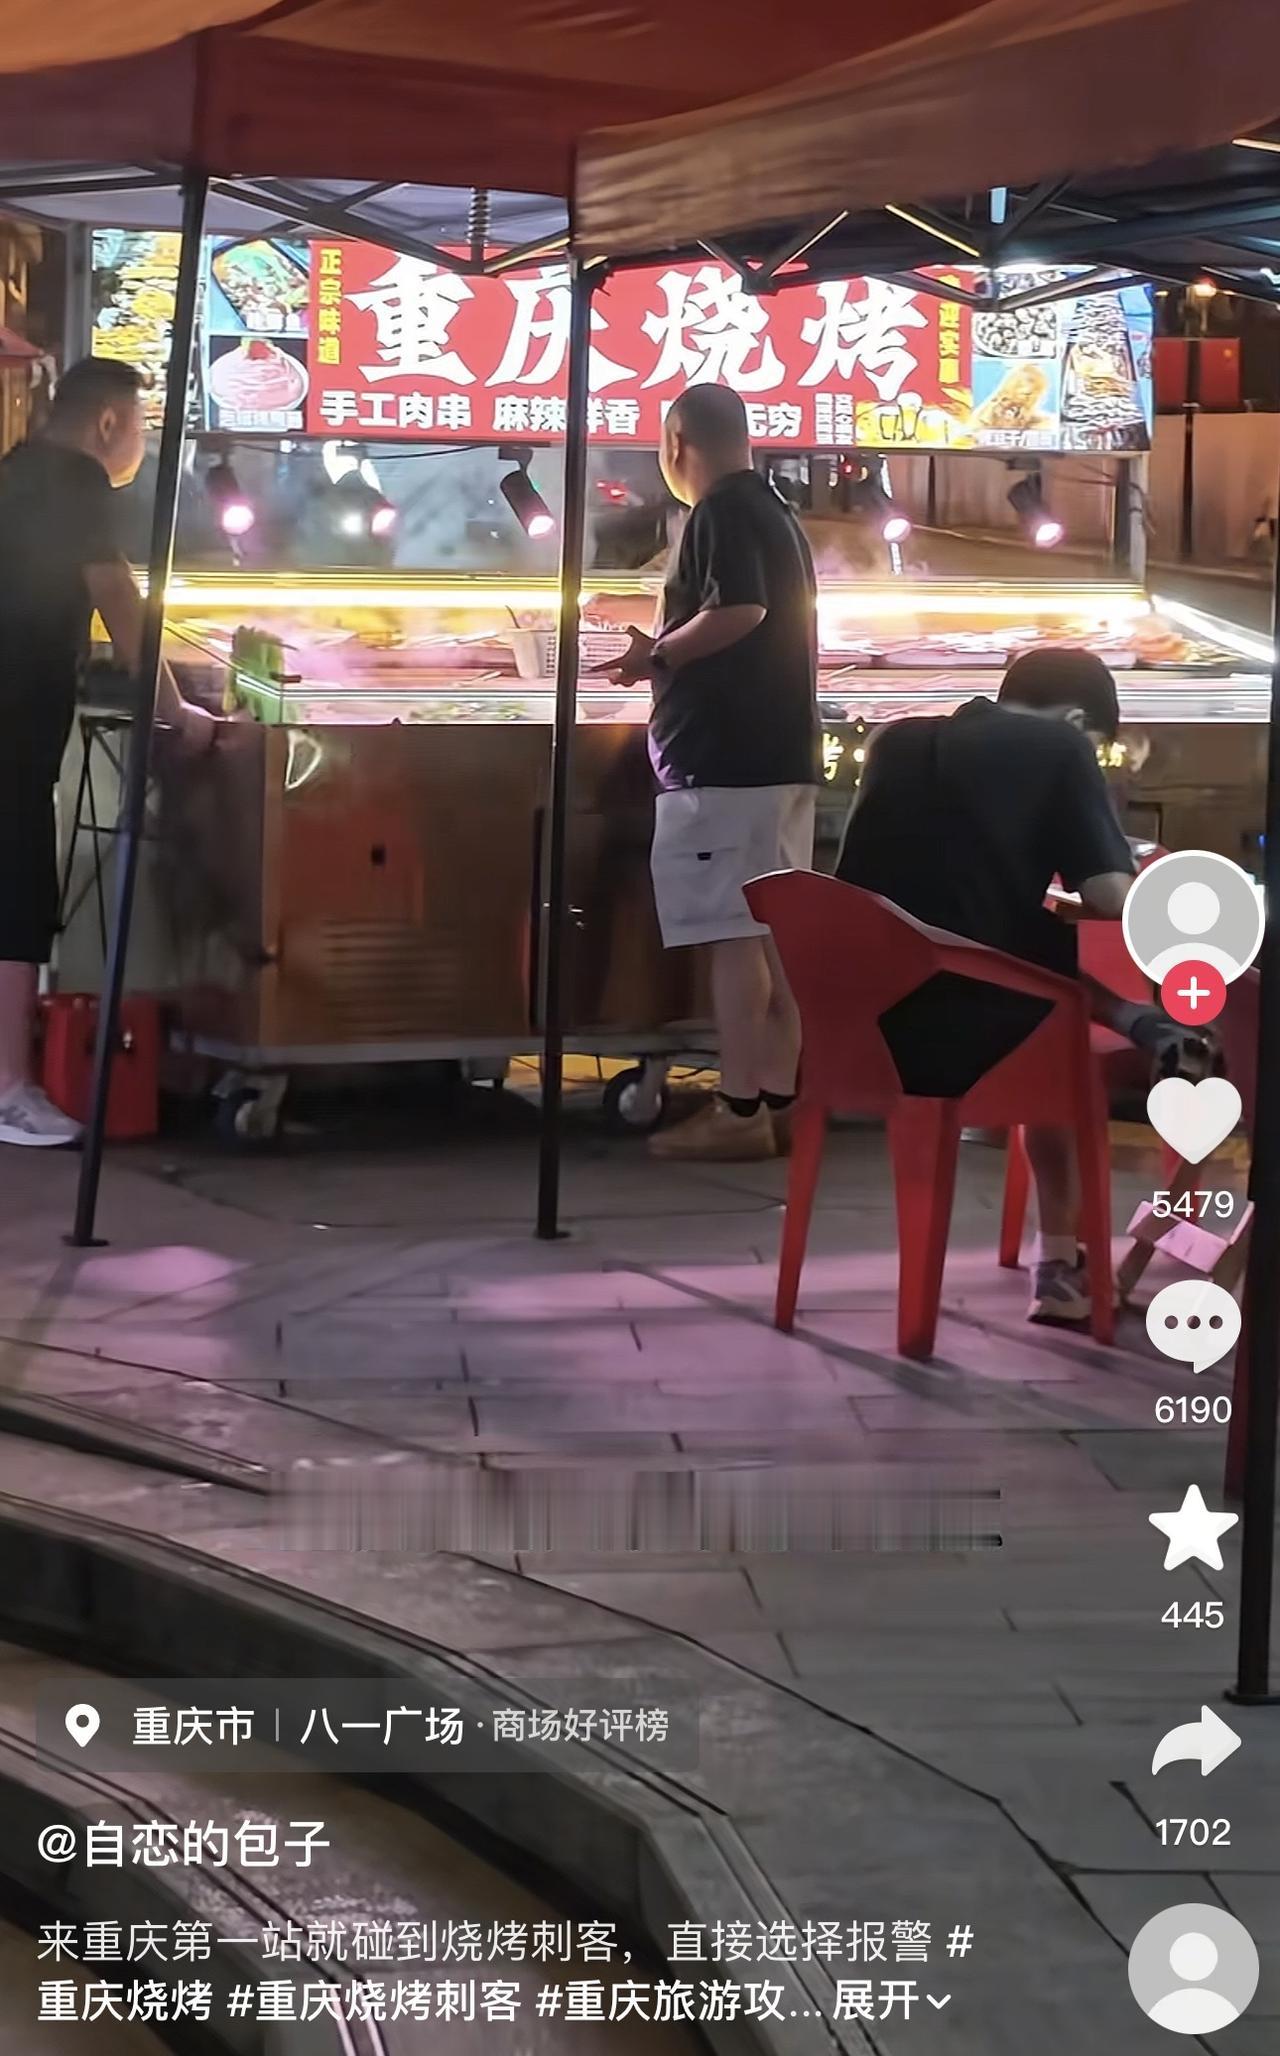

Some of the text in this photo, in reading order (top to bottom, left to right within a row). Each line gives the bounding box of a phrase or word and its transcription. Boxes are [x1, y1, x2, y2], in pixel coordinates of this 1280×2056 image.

[319, 248, 342, 365] 正宗味道
[345, 251, 929, 395] 重庆烧烤
[320, 390, 471, 430] 手工肉串
